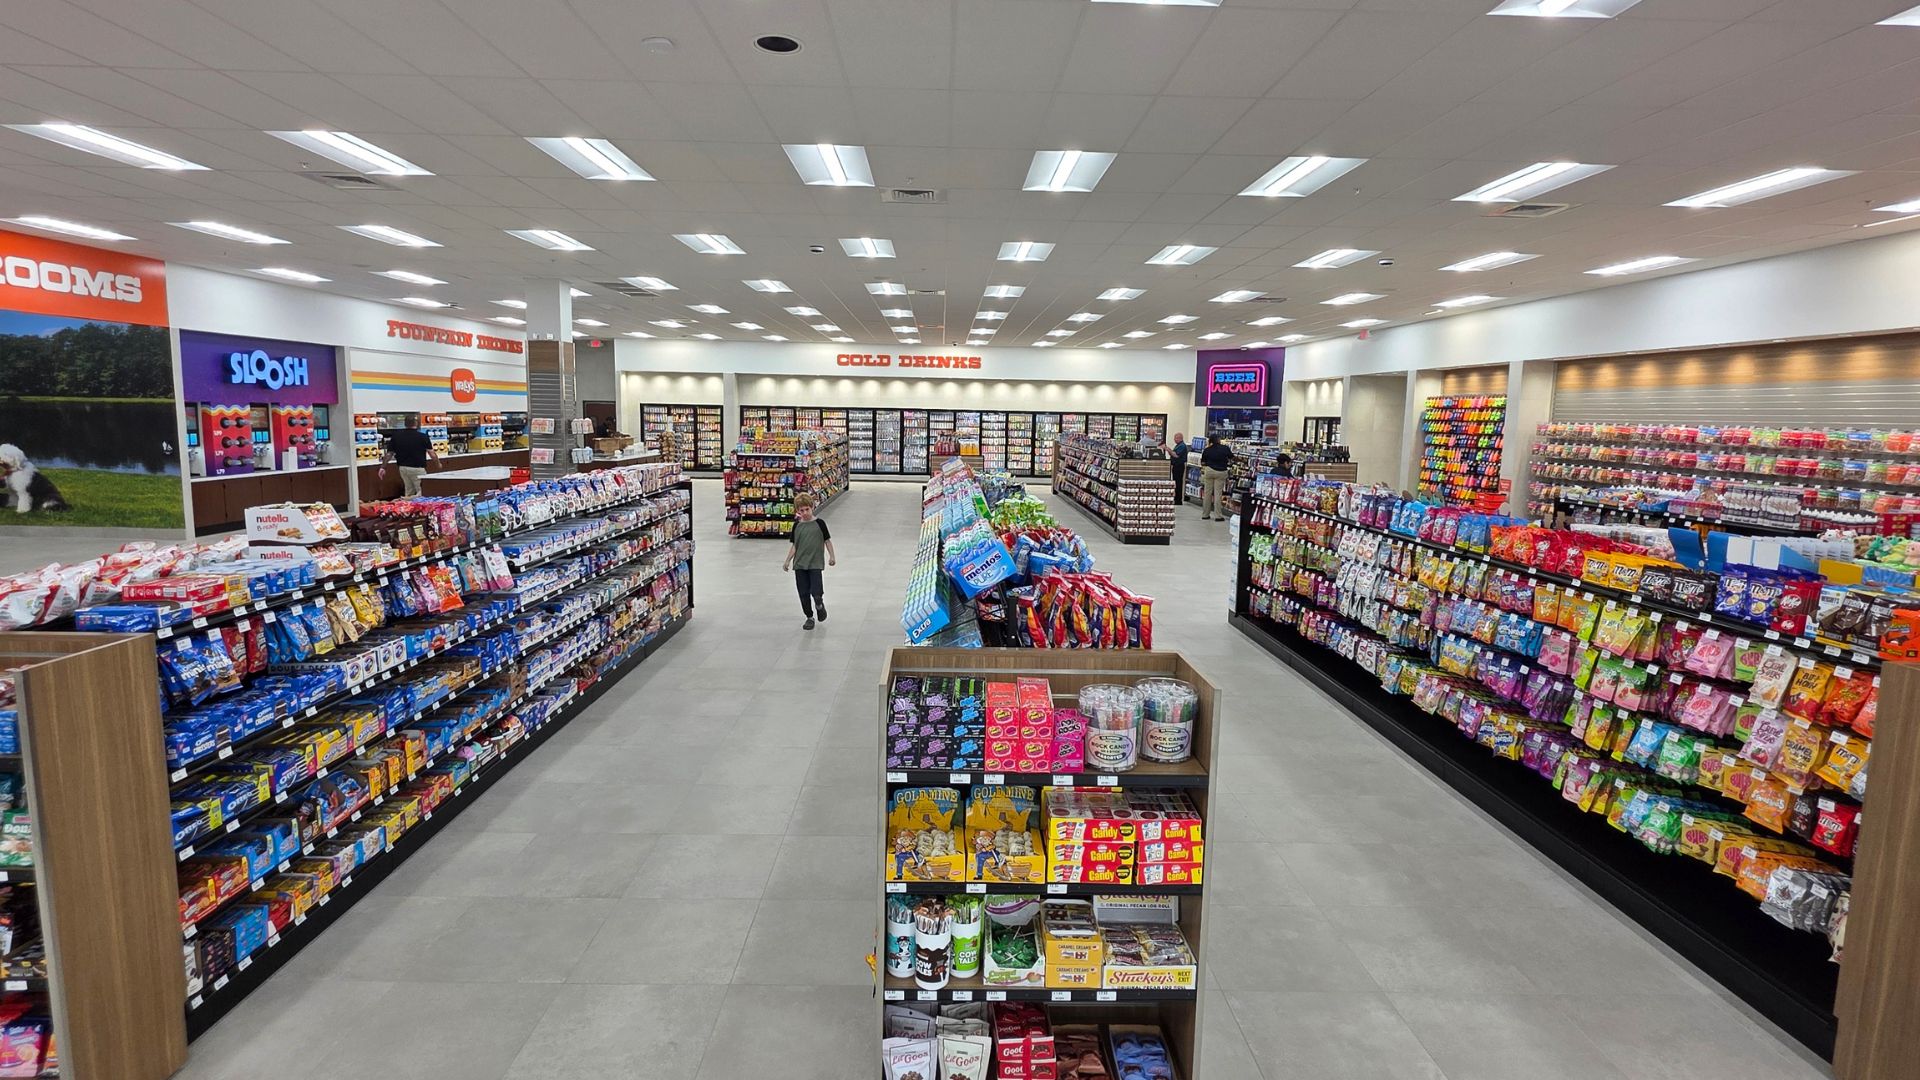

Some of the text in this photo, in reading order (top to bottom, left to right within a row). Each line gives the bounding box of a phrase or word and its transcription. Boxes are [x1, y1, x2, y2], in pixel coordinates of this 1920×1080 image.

[0, 255, 142, 303] OOMS
[387, 320, 524, 354] FOUNTAIN DRINKS
[837, 354, 982, 369] COLD DRINKS
[230, 350, 309, 390] SLOOSH
[1215, 372, 1256, 382] BEER
[1212, 383, 1258, 393] ARCADE
[256, 515, 289, 524] nutella
[260, 551, 293, 560] nutella
[965, 552, 1002, 581] mentos
[1058, 725, 1081, 736] ROCKS
[1091, 741, 1108, 749] ROCK
[896, 789, 959, 804] GOLD MINE
[974, 786, 1035, 800] GOLD MINE
[227, 791, 253, 810] OREO
[175, 819, 203, 841] OREO
[1092, 827, 1118, 840] Candy
[1165, 828, 1187, 838] Candy
[1090, 850, 1117, 862] Candy
[1168, 849, 1189, 860] Candy
[1089, 870, 1115, 882] Candy
[1167, 871, 1188, 882] Candy
[959, 951, 977, 959] COW
[1109, 970, 1174, 985] Stuckey's
[904, 1052, 928, 1064] Goos
[955, 1055, 980, 1067] Goos
